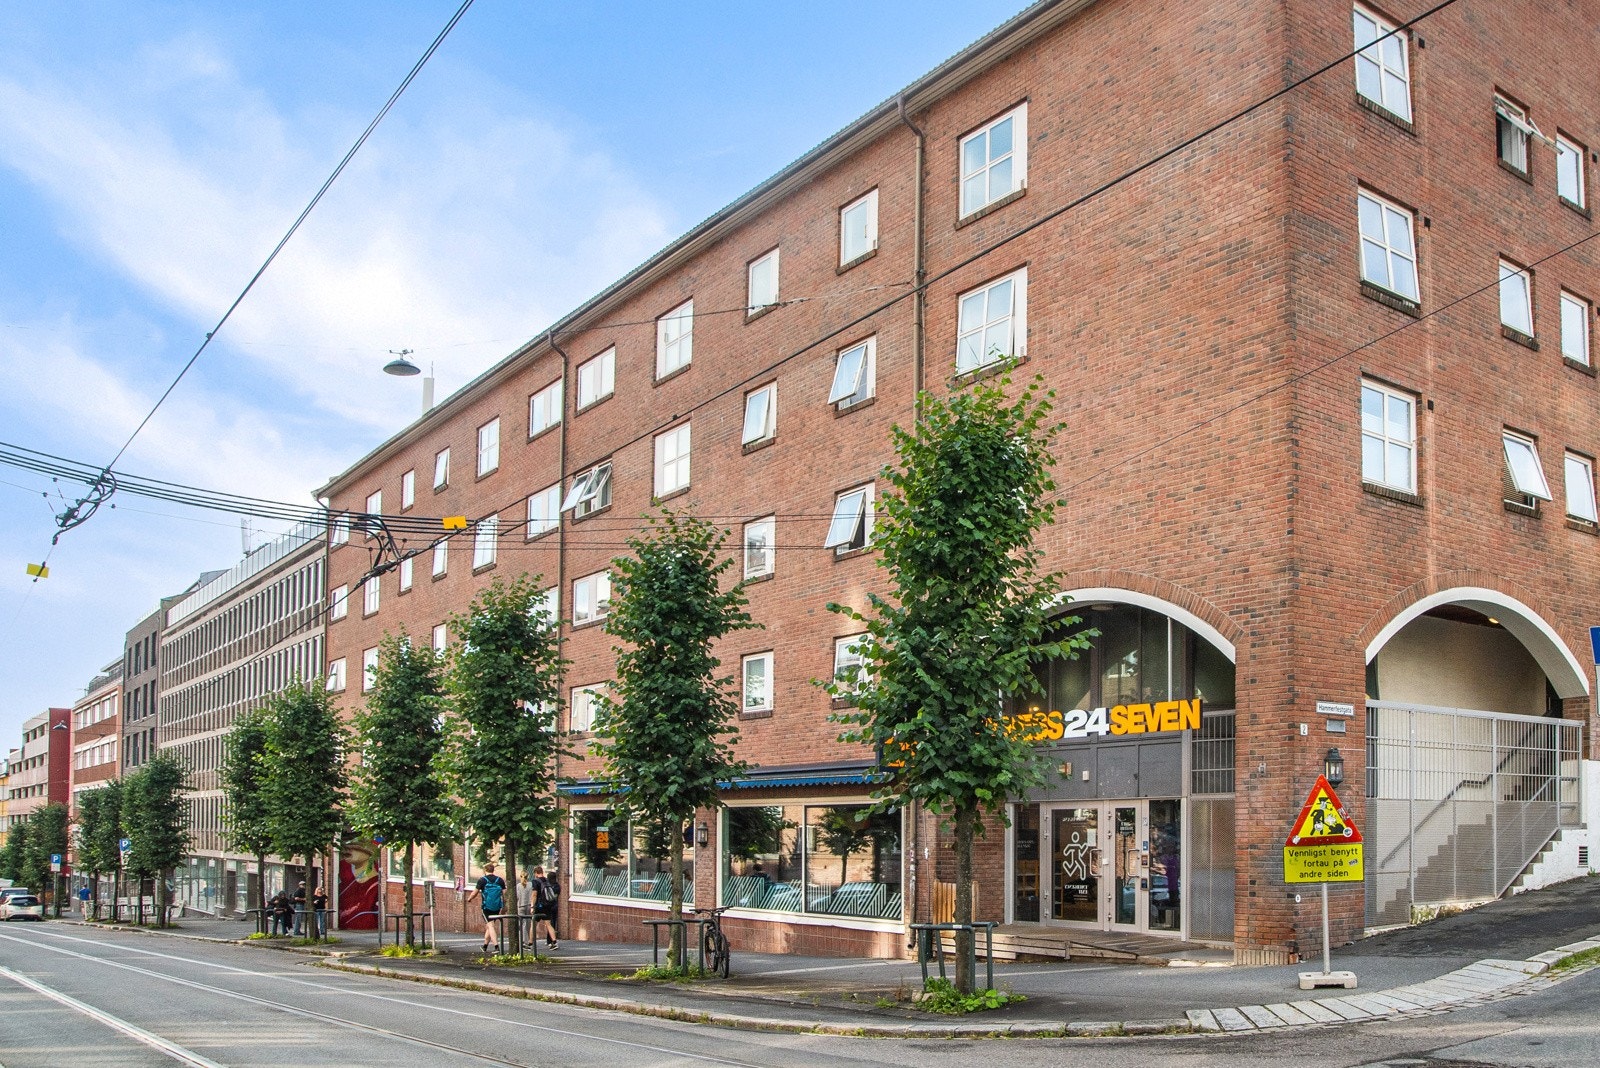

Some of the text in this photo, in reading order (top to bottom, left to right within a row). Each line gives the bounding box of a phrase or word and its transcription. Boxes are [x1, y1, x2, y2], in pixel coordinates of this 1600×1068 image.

[1288, 848, 1358, 858] Vennligst benytt
[1303, 859, 1329, 868] fortau
[1333, 859, 1344, 868] på
[1299, 870, 1349, 878] andre siden
